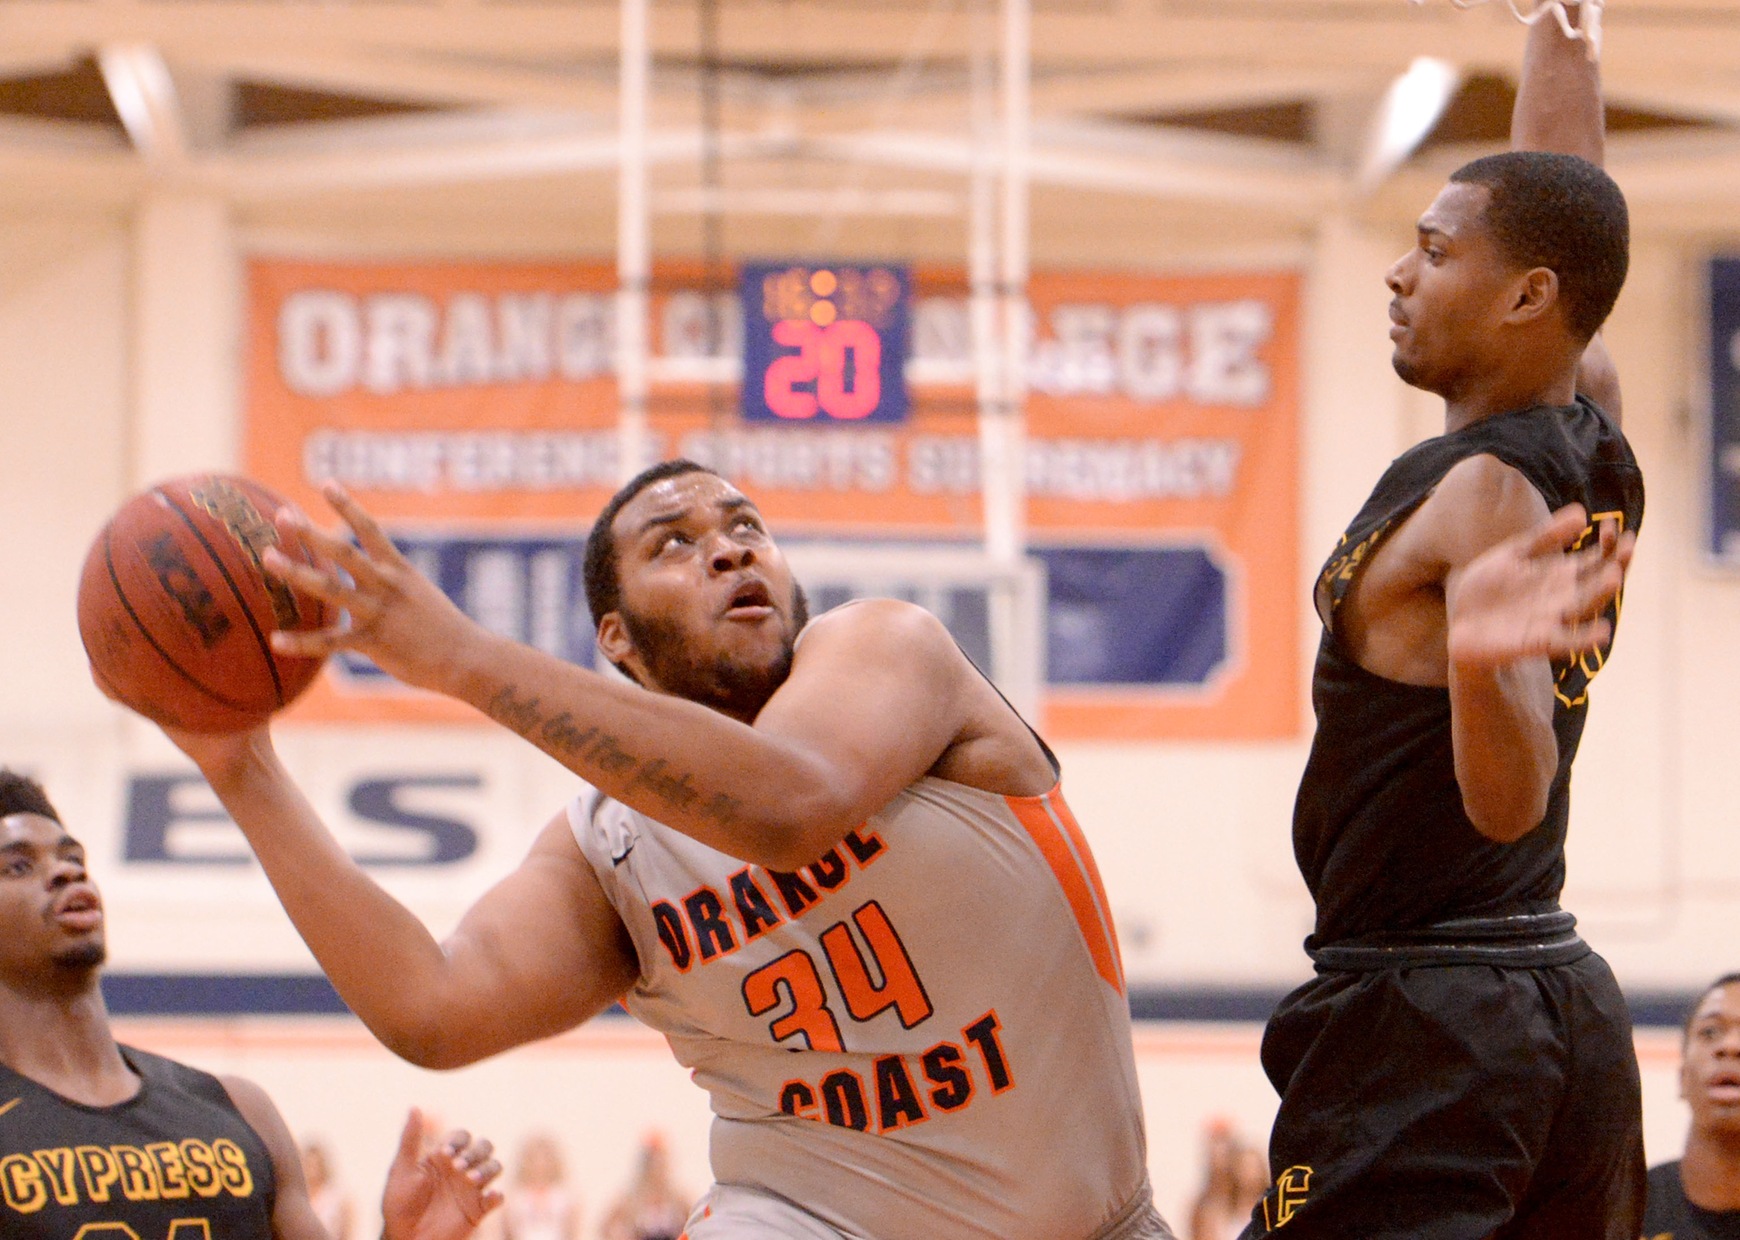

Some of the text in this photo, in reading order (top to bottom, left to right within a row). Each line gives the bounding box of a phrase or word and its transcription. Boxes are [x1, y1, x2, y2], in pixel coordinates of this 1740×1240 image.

[278, 291, 625, 396] ORANG
[763, 320, 882, 419] 20
[906, 437, 1242, 500] SUREMACY
[741, 899, 934, 1052] 34
[778, 1008, 1016, 1135] COAST
[0, 1138, 254, 1214] CYPRESS
